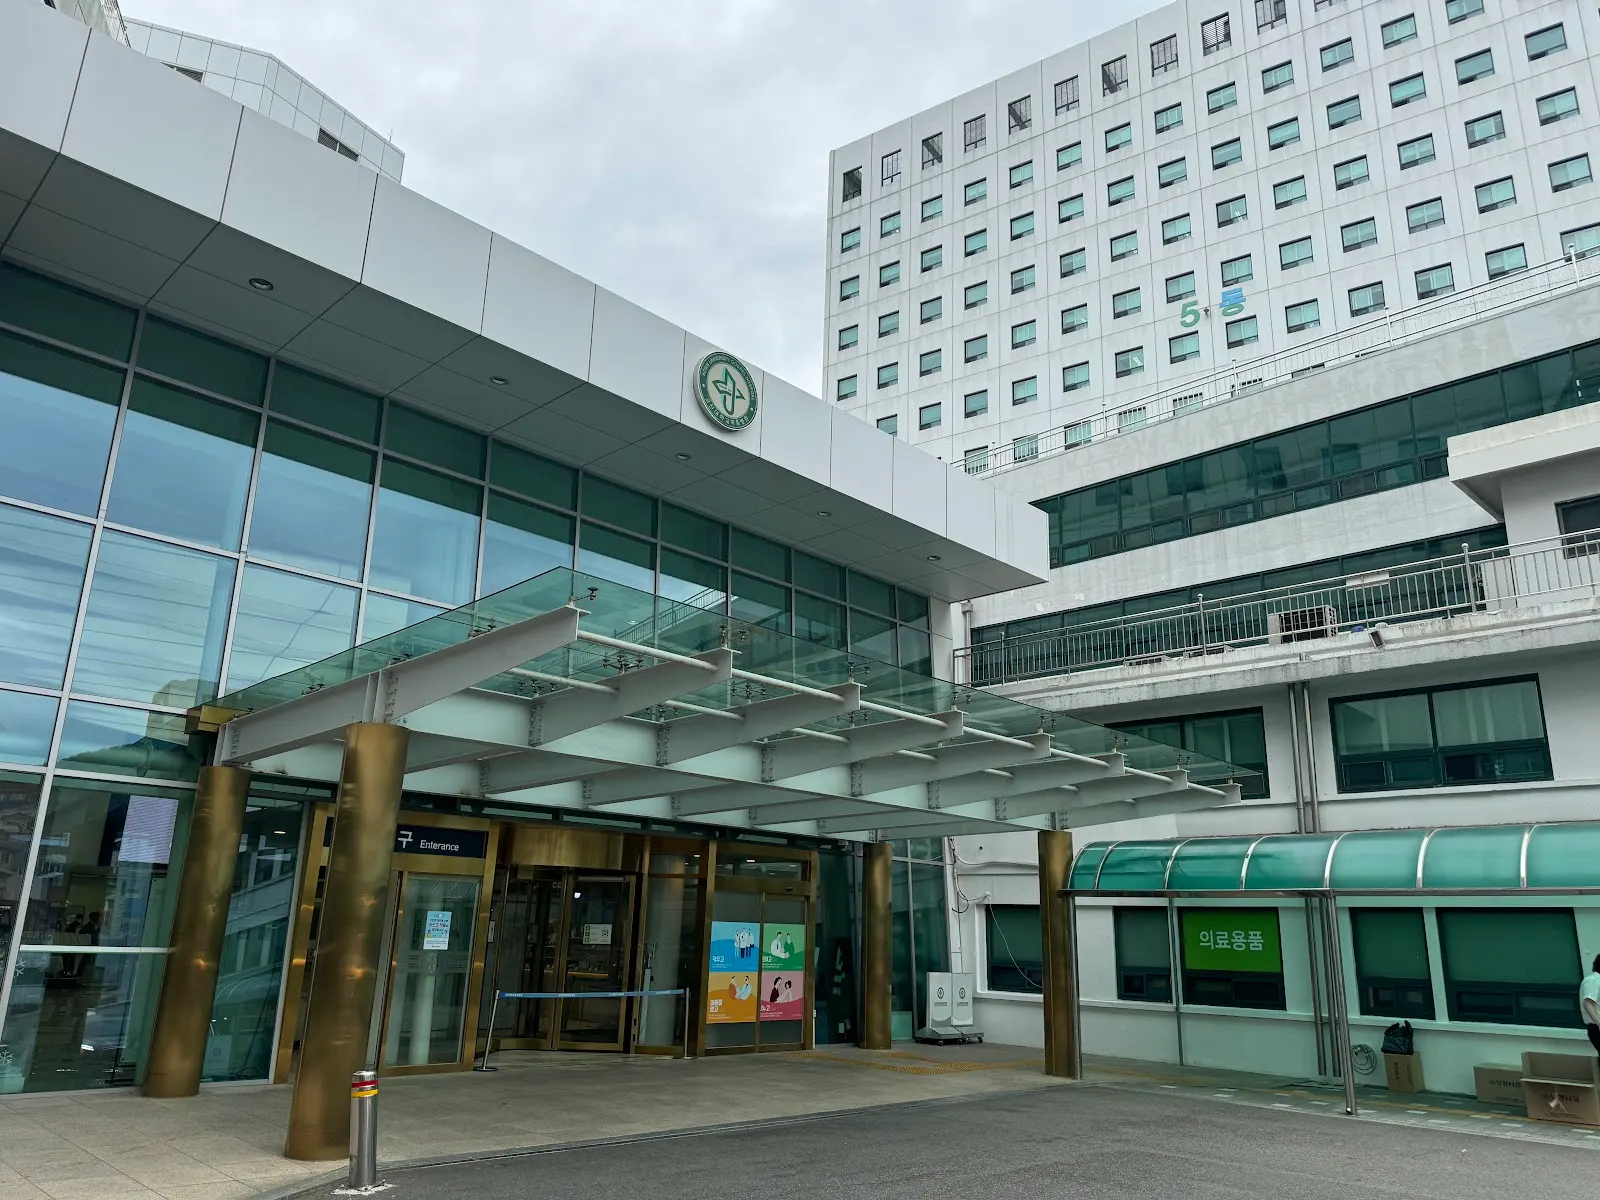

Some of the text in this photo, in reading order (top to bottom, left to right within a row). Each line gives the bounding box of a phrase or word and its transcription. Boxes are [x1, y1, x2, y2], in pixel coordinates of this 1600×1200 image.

[1180, 287, 1246, 328] 5동
[419, 839, 460, 852] Enterance
[1199, 929, 1264, 951] 의료용품
